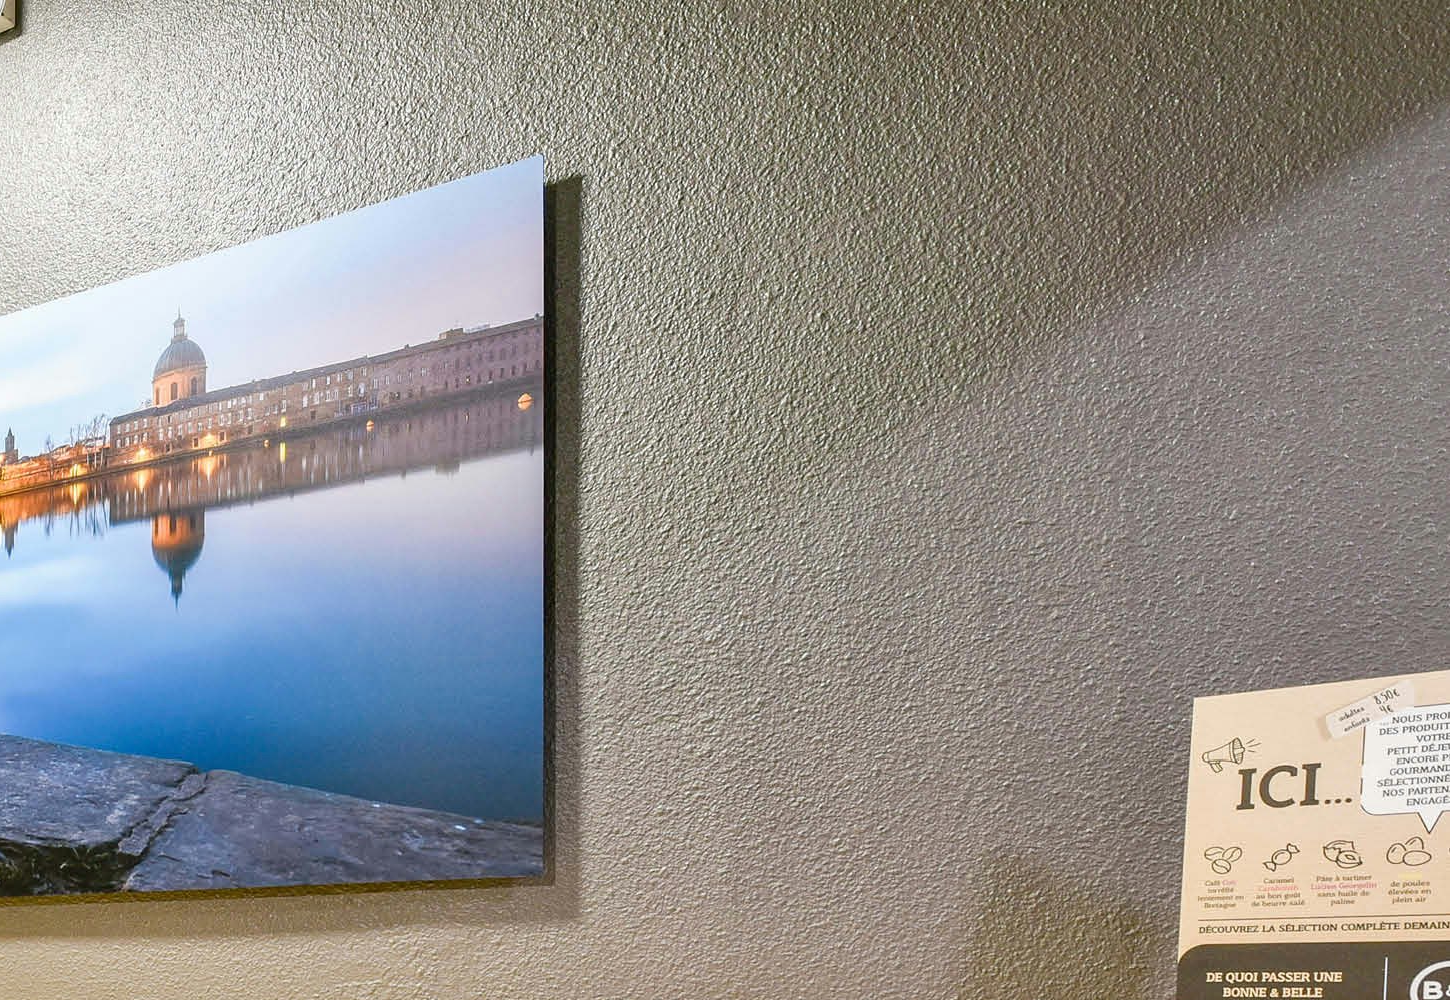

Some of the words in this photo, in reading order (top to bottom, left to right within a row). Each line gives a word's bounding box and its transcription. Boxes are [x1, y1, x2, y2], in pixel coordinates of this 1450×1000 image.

[1379, 726, 1399, 736] DES
[1387, 746, 1418, 756] PETIT
[1396, 754, 1439, 765] ENCORE
[1382, 788, 1405, 798] NOS
[1408, 785, 1450, 796] PARTEN
[1198, 925, 1259, 934] DÉCOUVREZ
[1262, 924, 1275, 933] LA
[1278, 923, 1338, 933] SÉLECTION
[1341, 921, 1401, 931] COMPLÈTE
[1404, 921, 1450, 930] DEMAIN
[1206, 972, 1223, 983] DE
[1225, 972, 1258, 983] QUOI
[1262, 971, 1311, 983] PASSER
[1314, 971, 1343, 983] UNE
[1223, 987, 1267, 998] BONNE
[1269, 987, 1279, 998] &
[1282, 987, 1323, 998] BELLE
